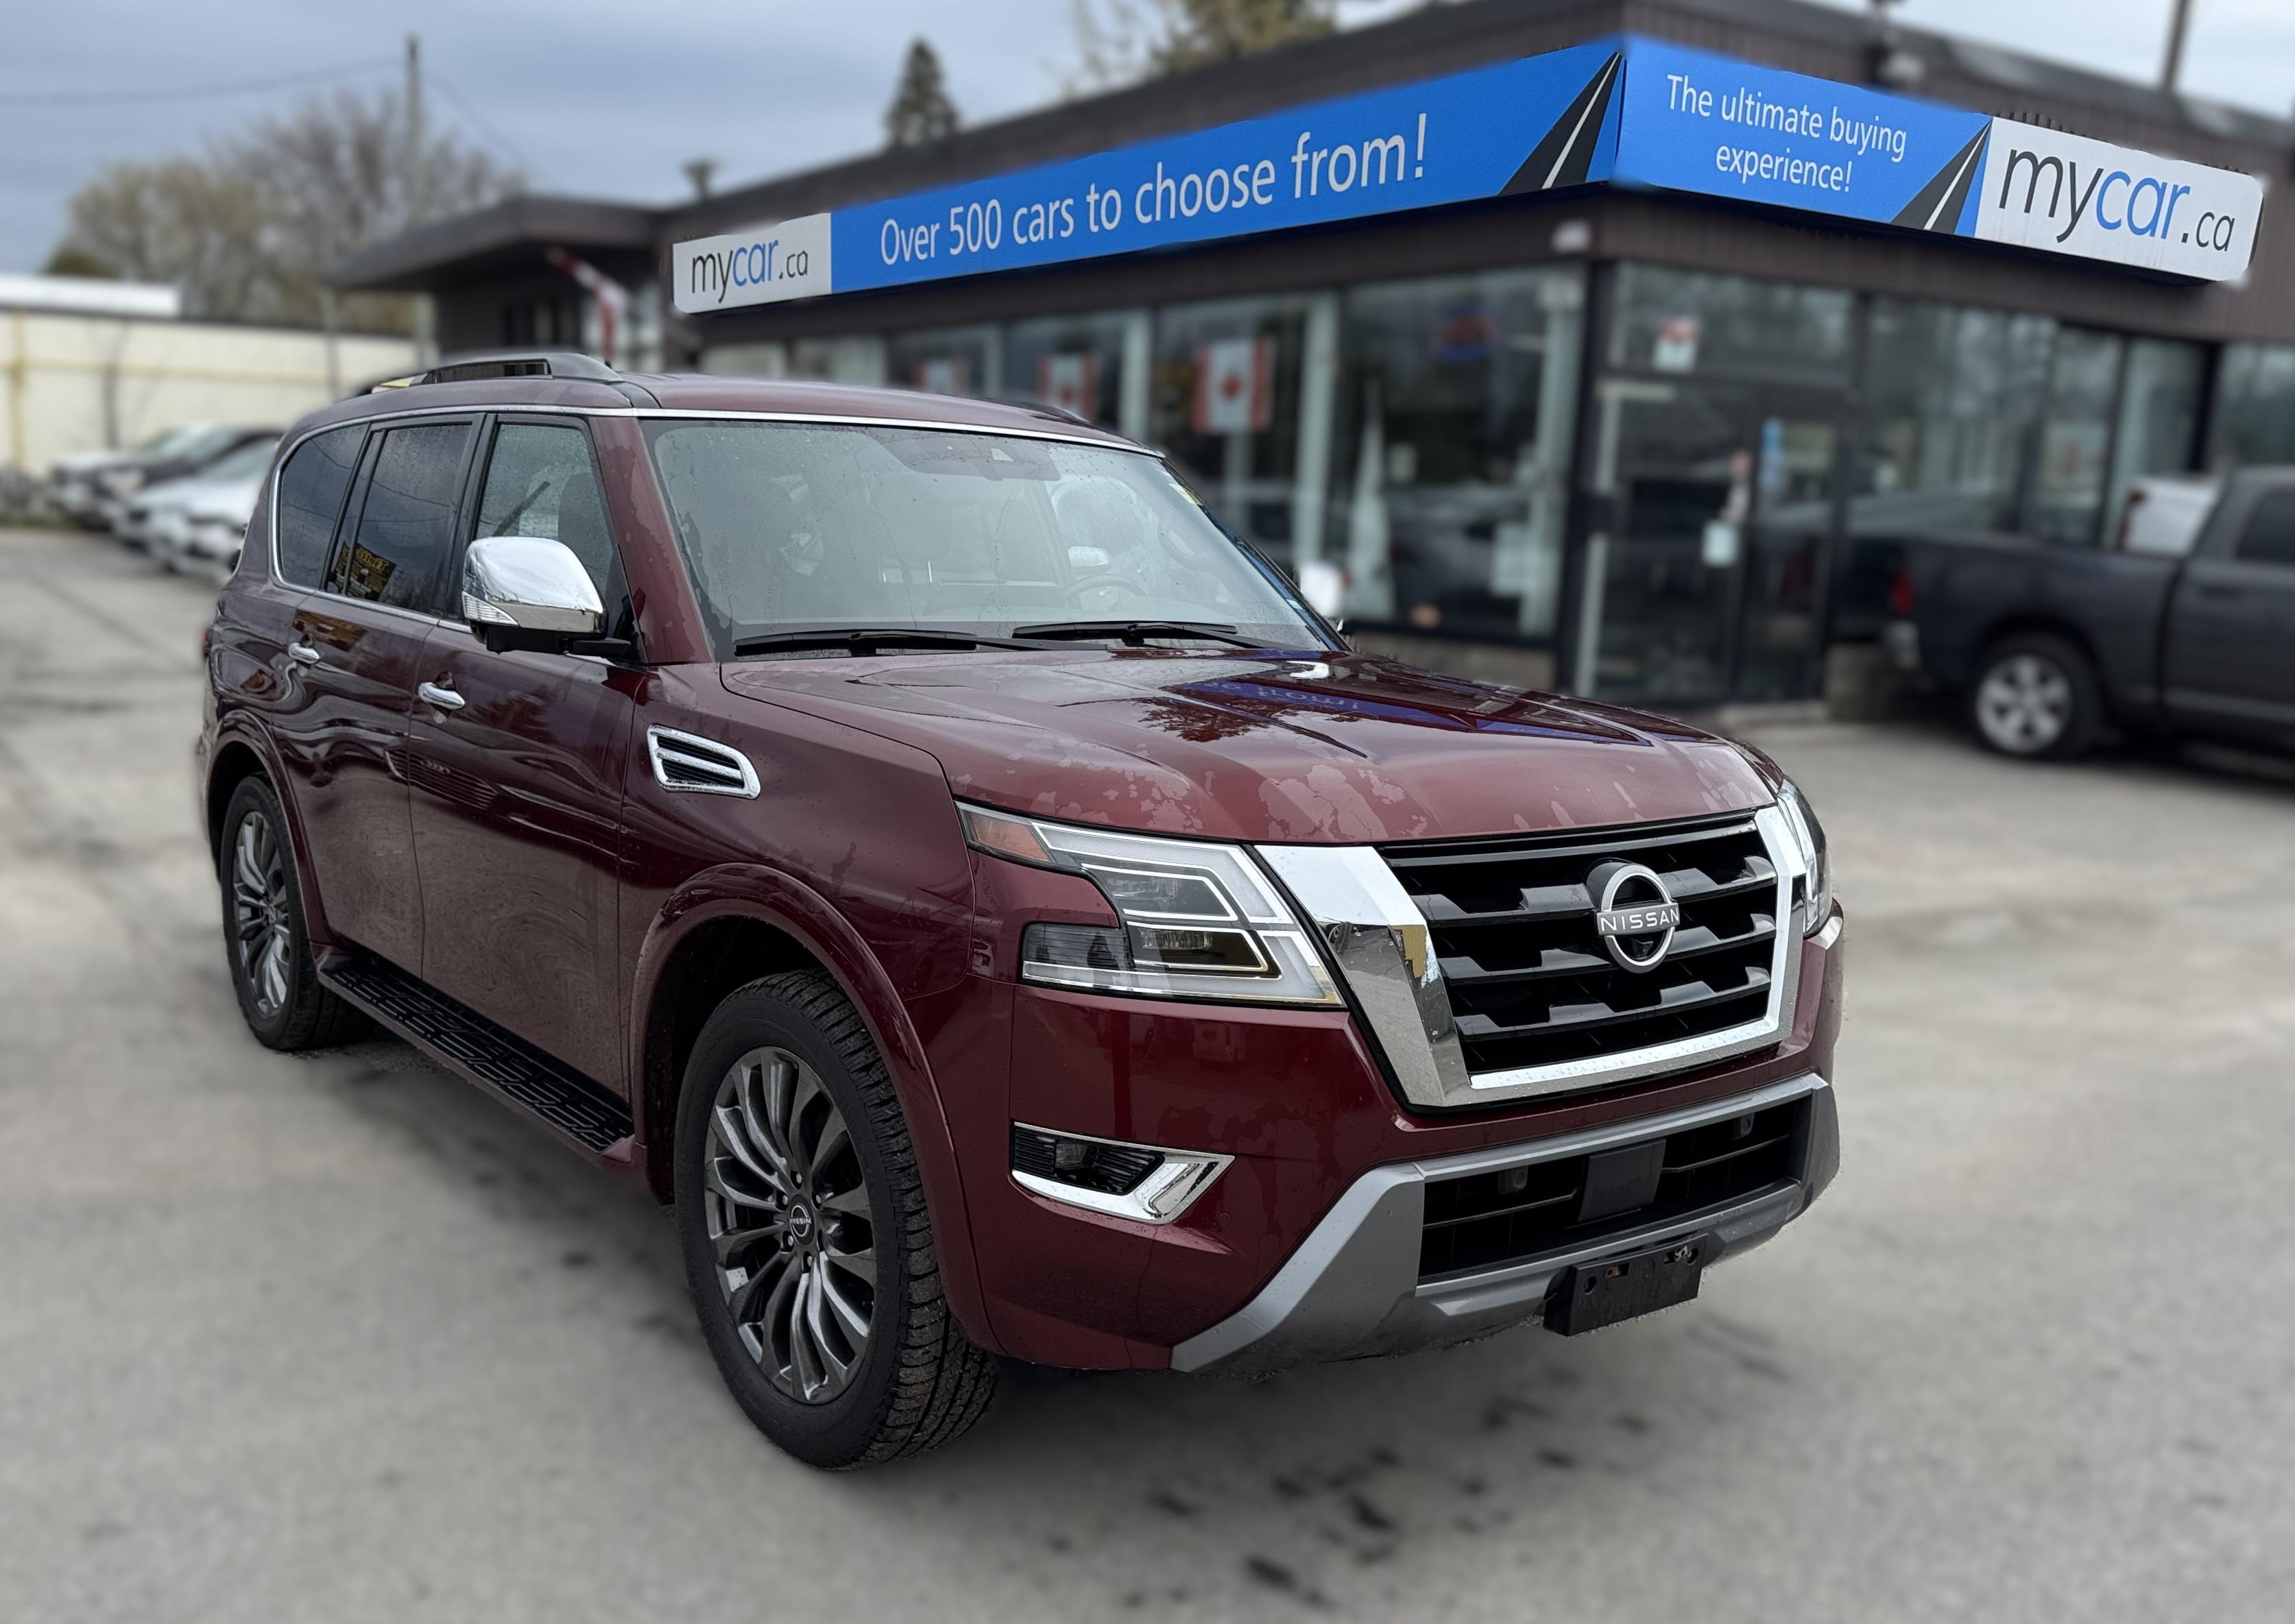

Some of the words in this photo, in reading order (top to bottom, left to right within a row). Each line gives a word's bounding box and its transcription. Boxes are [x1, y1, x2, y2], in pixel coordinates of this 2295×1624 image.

[1666, 73, 1714, 117] The
[1720, 86, 1823, 138] ultimate
[1829, 106, 1907, 163] buying
[880, 218, 940, 266] Over
[948, 199, 1002, 256] 500
[1011, 195, 1074, 245] cars
[1085, 182, 1122, 234] to
[1135, 161, 1275, 222] choose
[1291, 112, 1427, 199] from!
[1716, 144, 1853, 193] experience!
[1998, 148, 2236, 252] mycar.ca
[690, 239, 809, 303] mycar.ca
[1600, 907, 1680, 932] NISSAN
